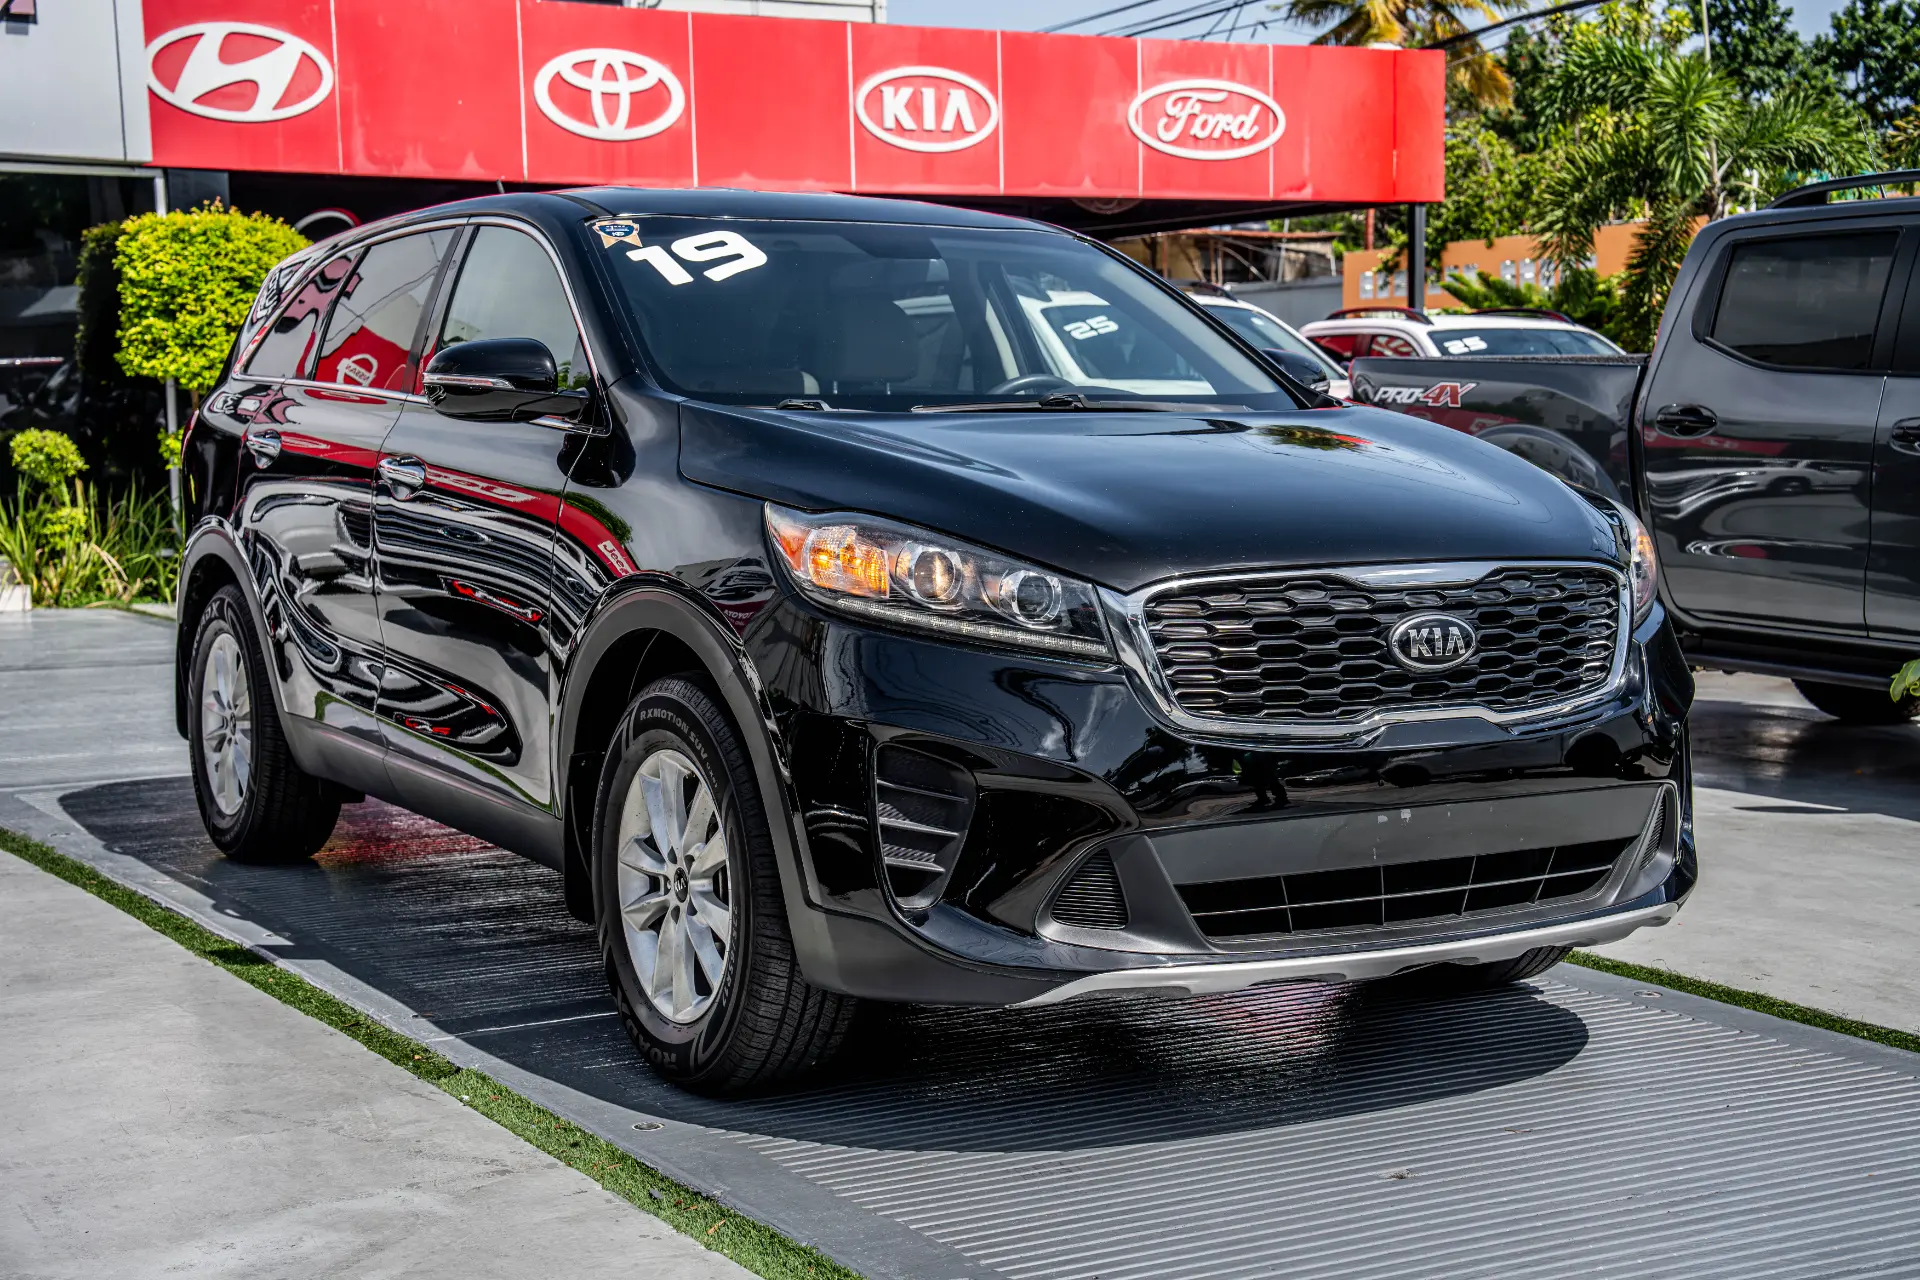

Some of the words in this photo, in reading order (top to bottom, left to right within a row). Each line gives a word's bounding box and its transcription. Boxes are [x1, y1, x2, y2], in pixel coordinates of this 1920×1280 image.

[879, 86, 977, 133] KIA
[1156, 90, 1261, 142] Ford
[626, 230, 768, 286] 19
[1063, 315, 1119, 340] 25
[1373, 382, 1477, 407] PRO-4X
[1408, 626, 1466, 657] KIA
